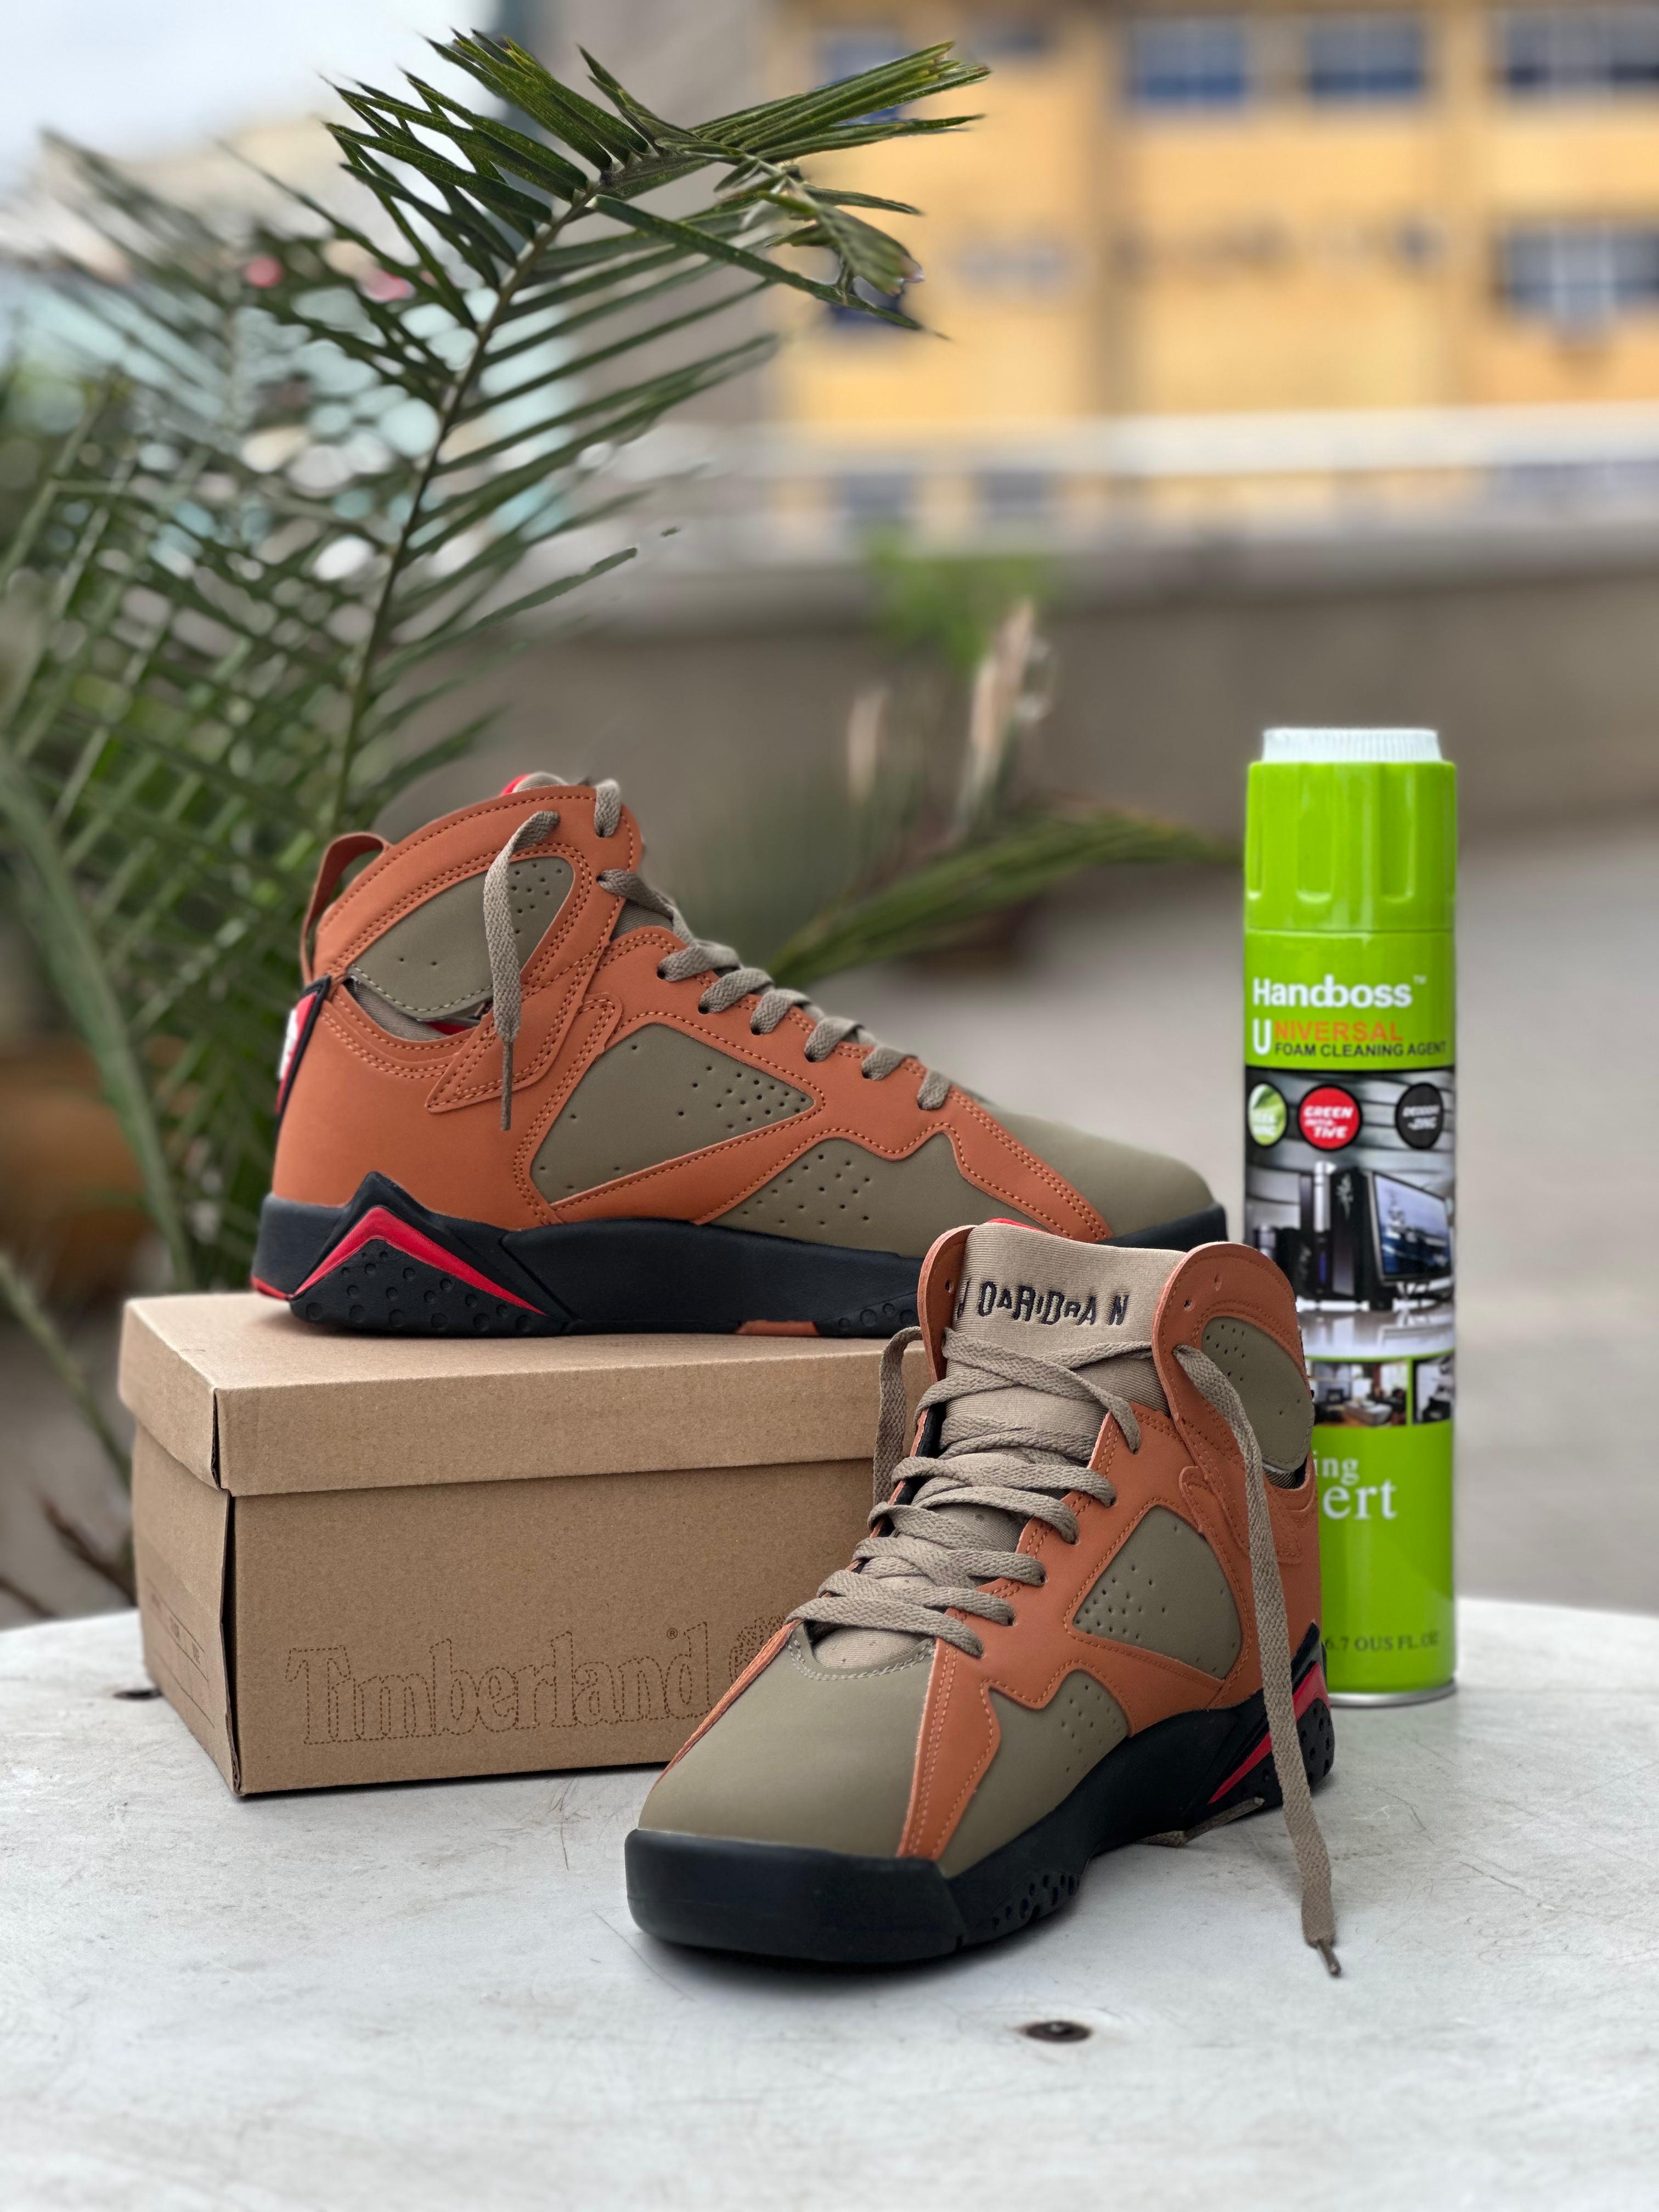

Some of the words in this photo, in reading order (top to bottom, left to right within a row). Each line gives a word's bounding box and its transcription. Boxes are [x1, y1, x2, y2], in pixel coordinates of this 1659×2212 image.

[1252, 973, 1413, 1008] Handboss
[1274, 1042, 1317, 1056] FOAM
[1321, 1043, 1404, 1058] CLEANING
[1407, 1040, 1446, 1056] AGENT
[1322, 1479, 1398, 1520] ert
[285, 1621, 713, 1745] Timberland
